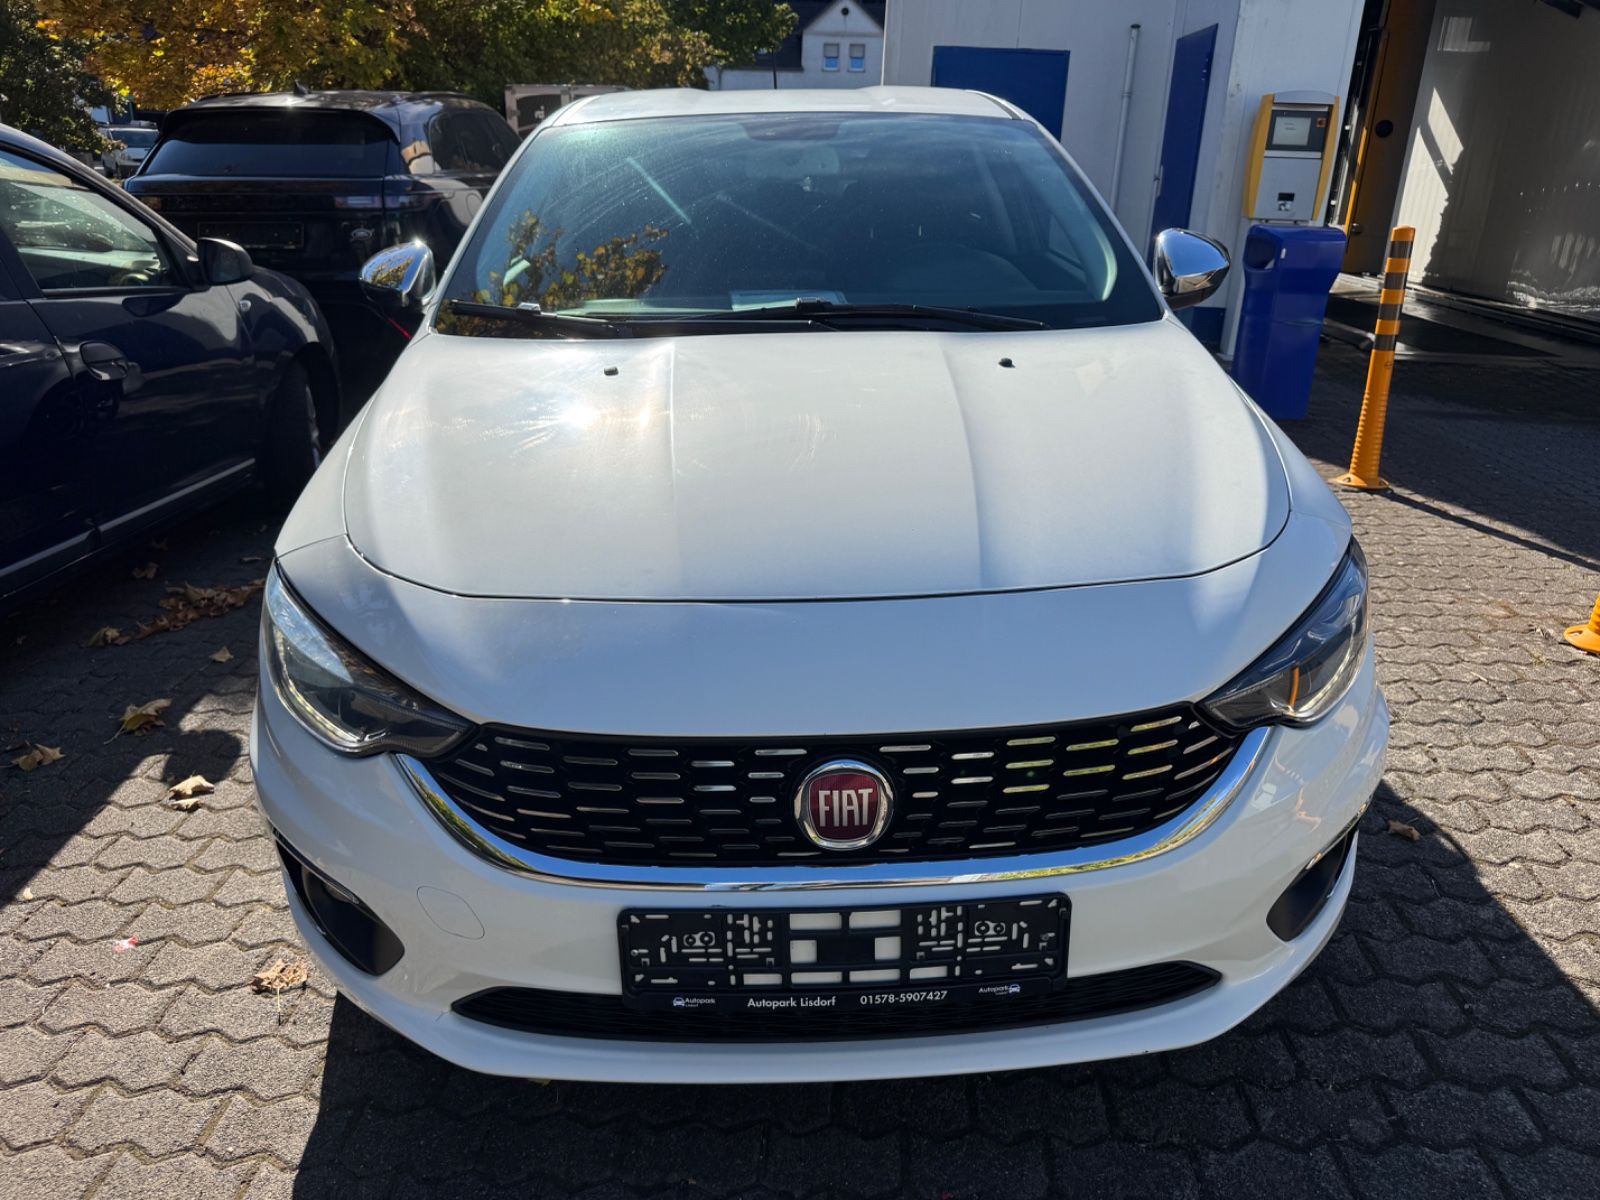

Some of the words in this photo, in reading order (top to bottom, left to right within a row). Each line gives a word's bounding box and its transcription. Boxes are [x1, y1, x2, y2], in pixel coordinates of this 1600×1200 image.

[818, 788, 874, 827] FIAT
[685, 997, 716, 1005] Autopark
[747, 996, 798, 1010] Autopark
[800, 996, 836, 1007] Lisdorf
[860, 990, 948, 1005] 01578-5907427
